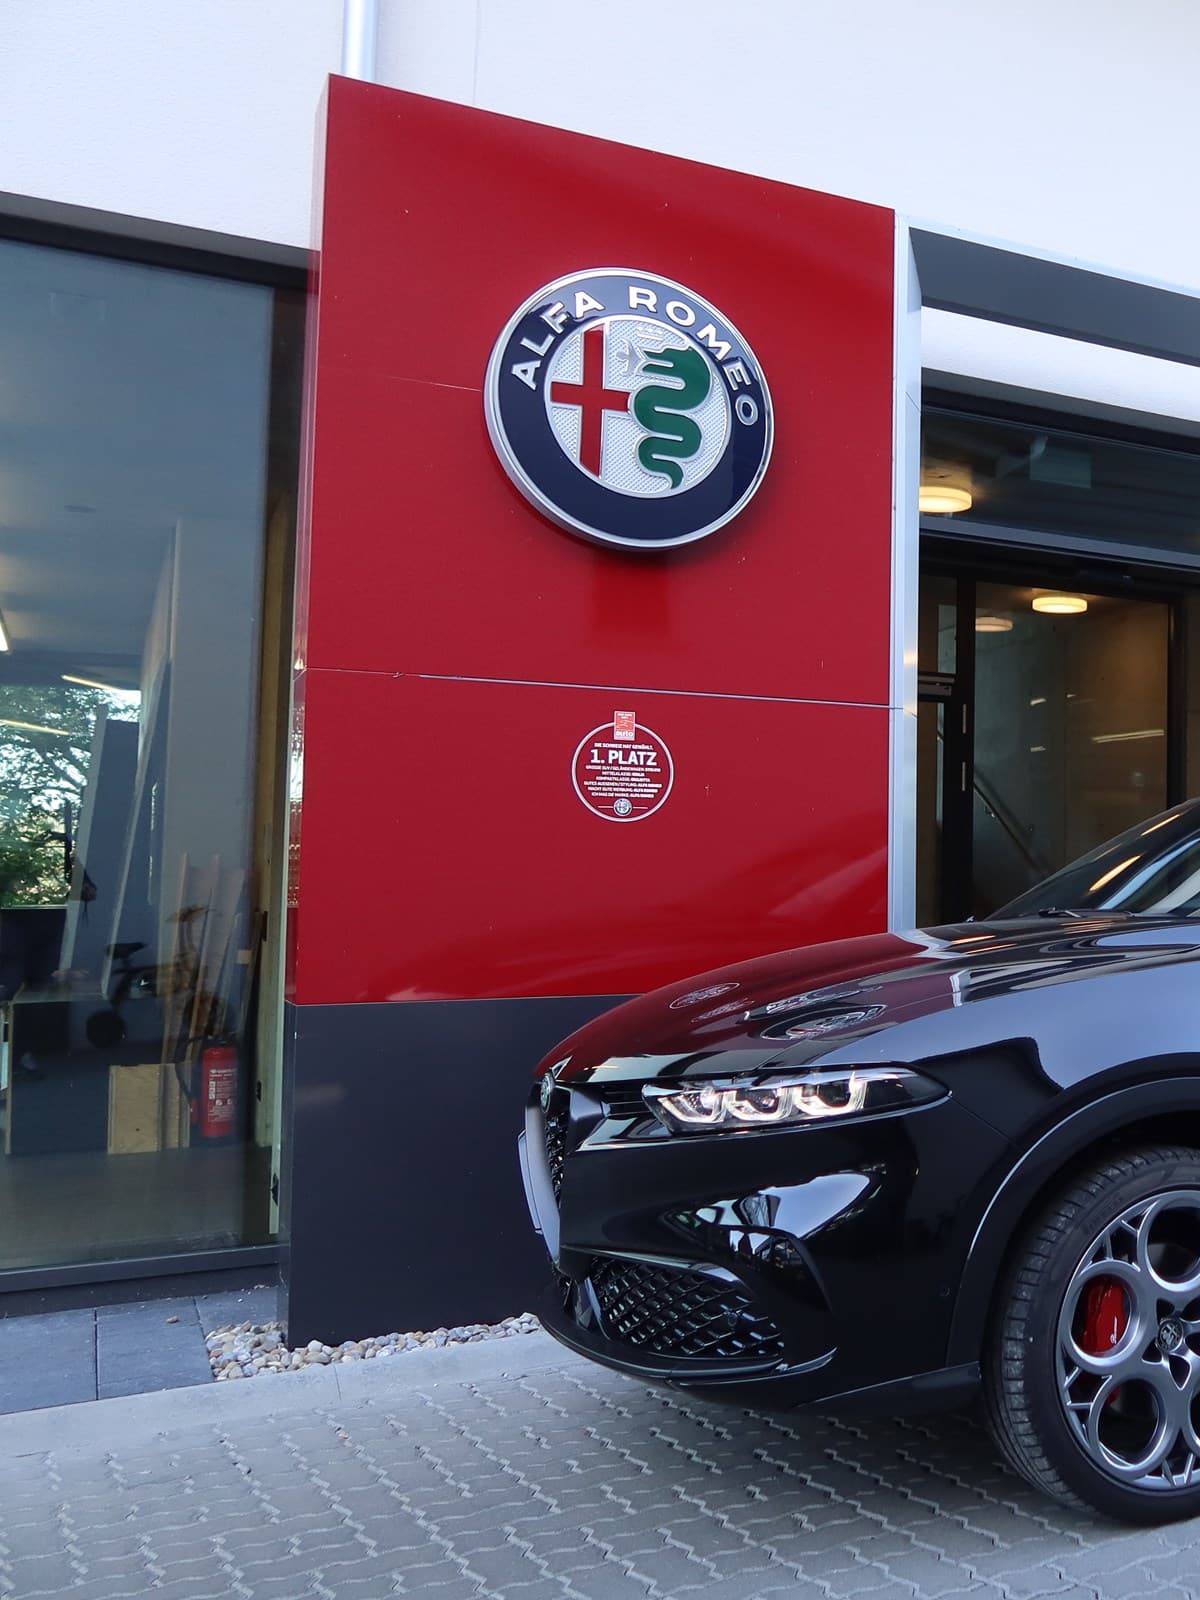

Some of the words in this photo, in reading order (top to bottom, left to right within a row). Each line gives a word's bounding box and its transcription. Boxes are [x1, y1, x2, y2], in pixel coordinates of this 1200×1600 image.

[511, 291, 604, 390] ALFA
[629, 286, 758, 426] ROMEO
[590, 749, 605, 763] 1.
[608, 750, 657, 766] PLATZ
